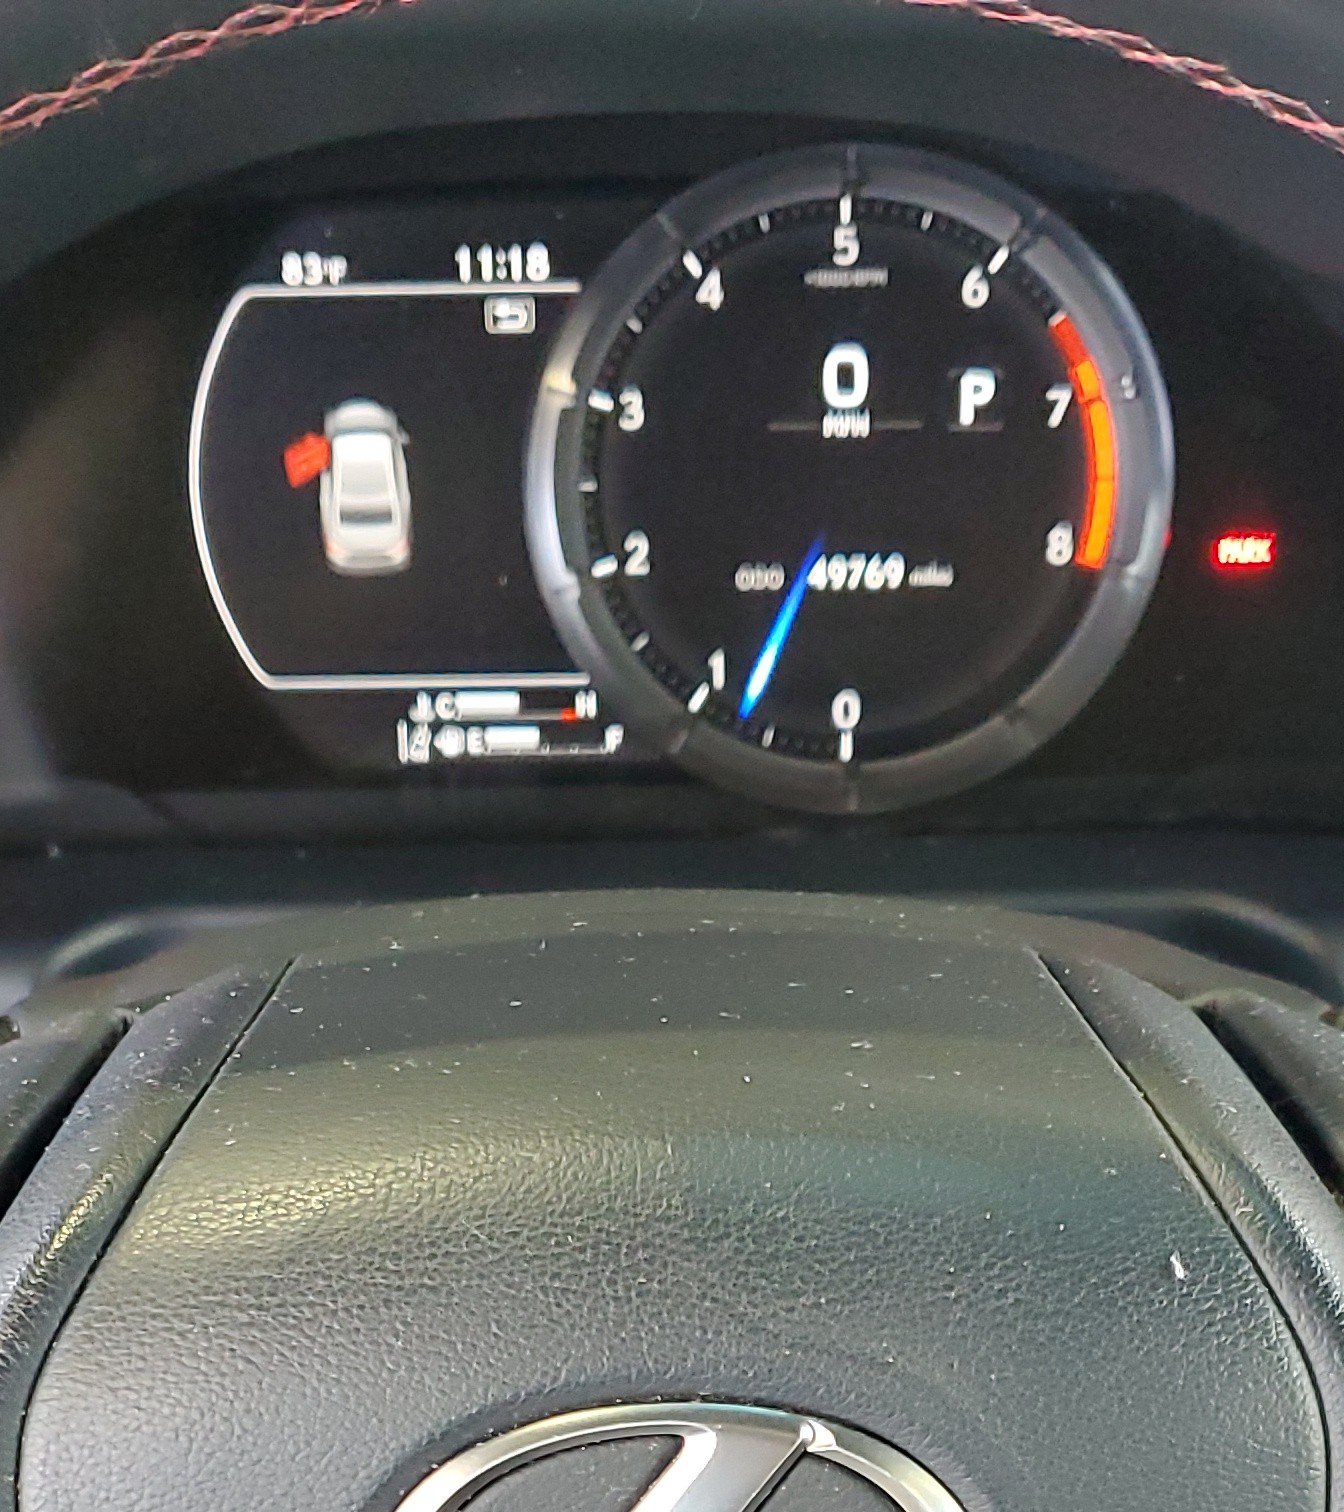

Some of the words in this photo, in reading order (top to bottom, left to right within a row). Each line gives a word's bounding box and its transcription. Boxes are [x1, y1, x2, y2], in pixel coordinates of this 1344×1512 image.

[456, 242, 550, 283] 11:18
[832, 224, 860, 267] 5
[696, 268, 724, 310] 4
[962, 265, 990, 309] 6
[822, 341, 869, 408] 0
[960, 367, 996, 426] P
[619, 388, 645, 431] 3
[1046, 384, 1074, 428] 7
[624, 530, 650, 577] 2
[1046, 522, 1075, 567] 8
[807, 551, 905, 591] 49769
[707, 647, 725, 691] 1
[832, 688, 861, 733] 0
